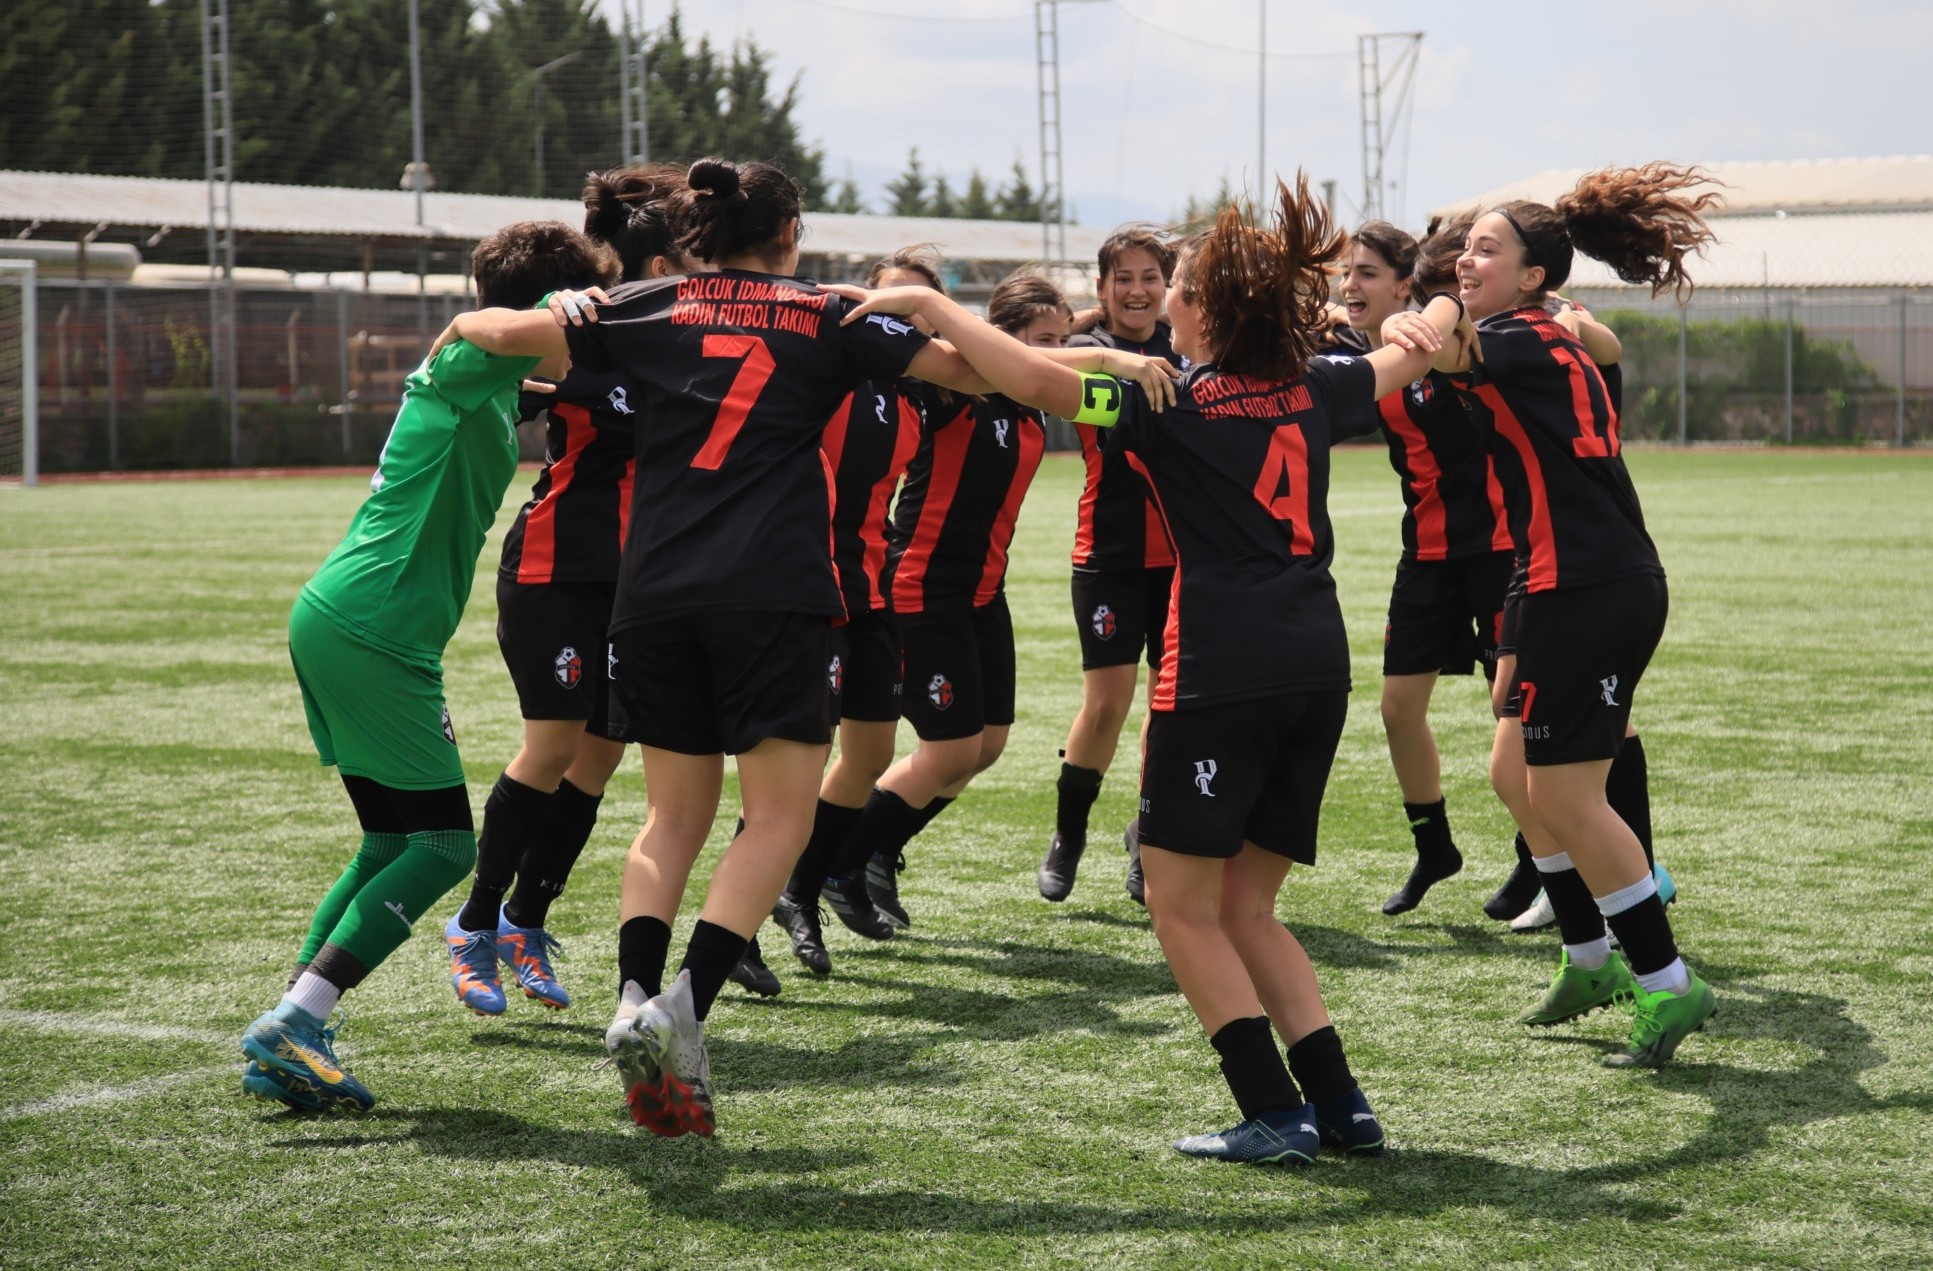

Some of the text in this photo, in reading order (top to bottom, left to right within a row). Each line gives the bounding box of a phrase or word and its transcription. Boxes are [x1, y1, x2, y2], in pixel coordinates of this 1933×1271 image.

[671, 302, 821, 339] KADIN FUTBOL TAKIMI
[690, 334, 776, 471] 7
[1084, 378, 1120, 412] C
[1253, 423, 1315, 555] 4
[1521, 682, 1537, 723] 7
